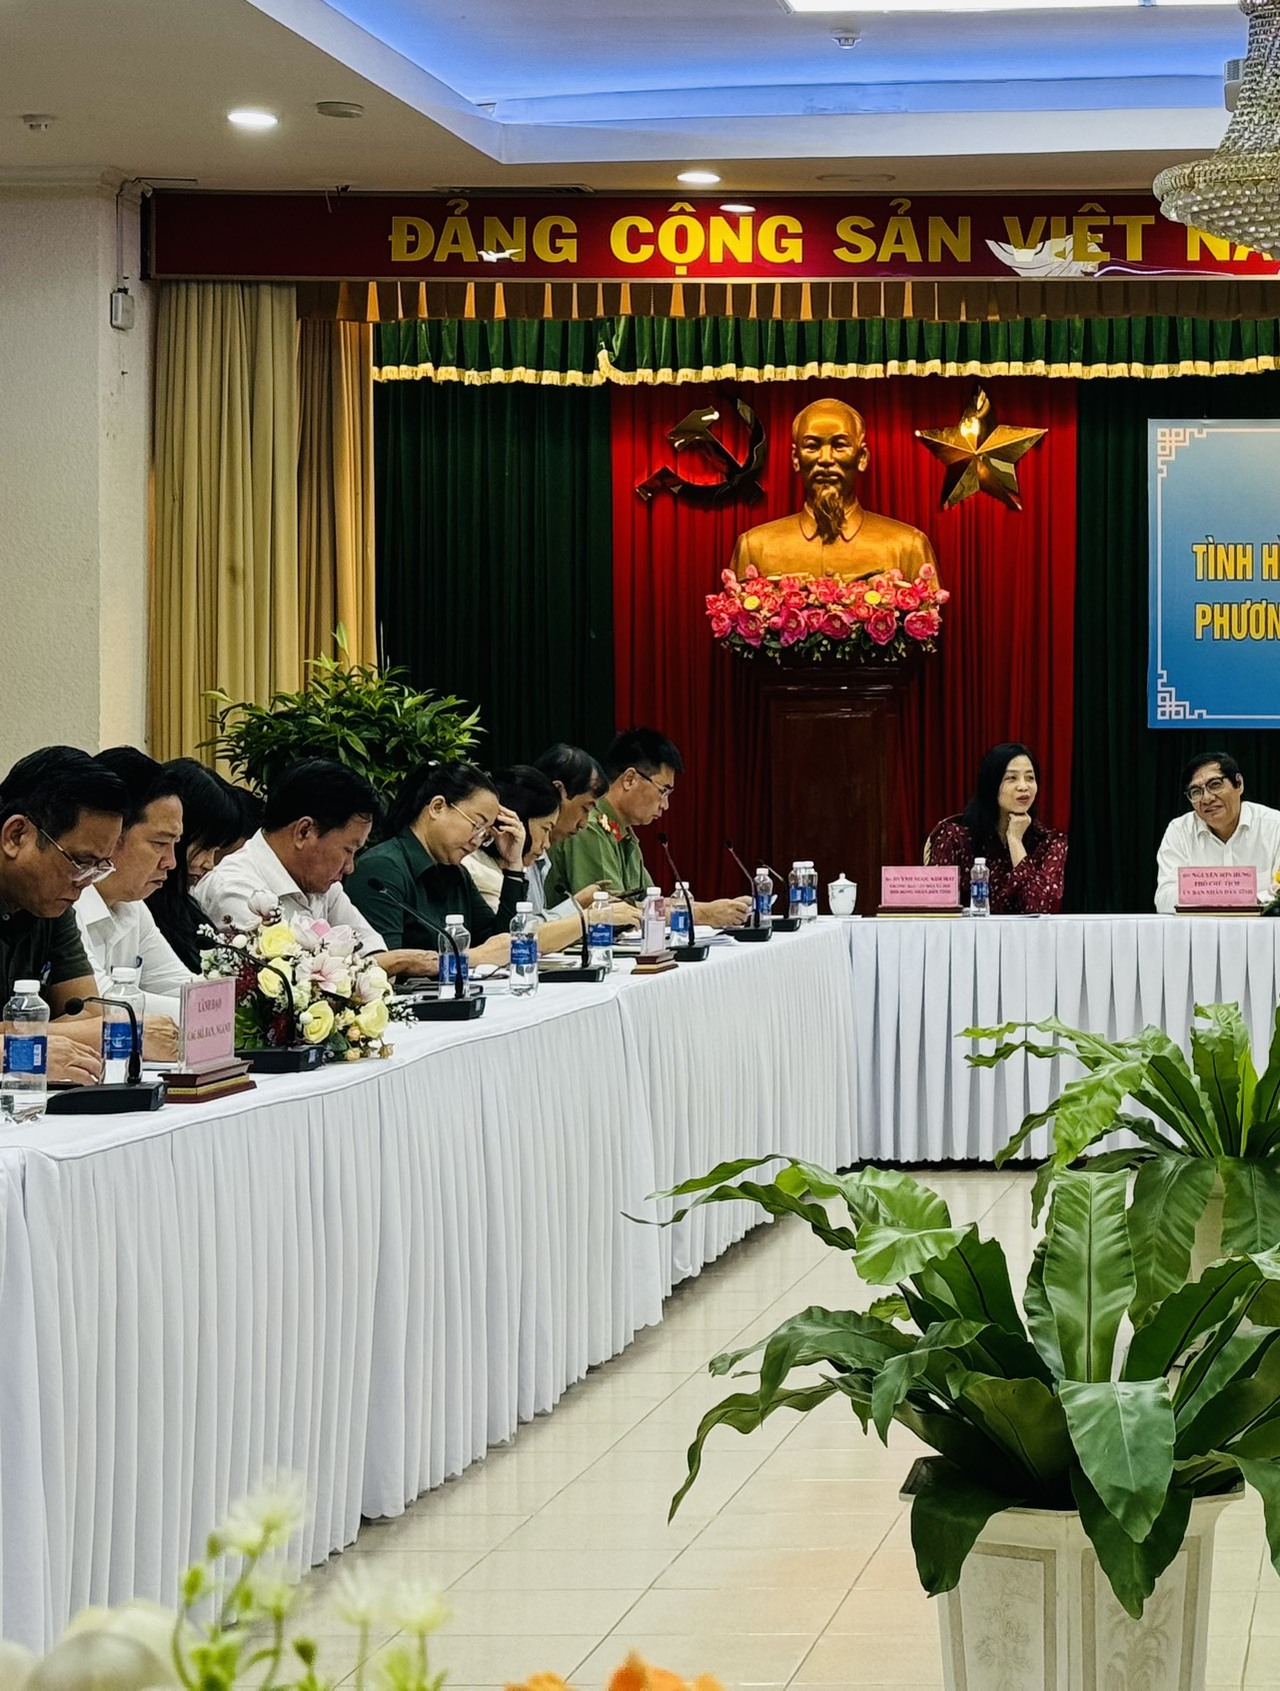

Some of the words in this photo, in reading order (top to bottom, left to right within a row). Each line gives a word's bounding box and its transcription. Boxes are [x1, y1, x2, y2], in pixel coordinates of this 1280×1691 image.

[388, 199, 577, 263] ĐẢNG
[610, 202, 803, 275] CỘNG
[833, 198, 972, 263] SẢN
[1192, 535, 1253, 581] TÌNH
